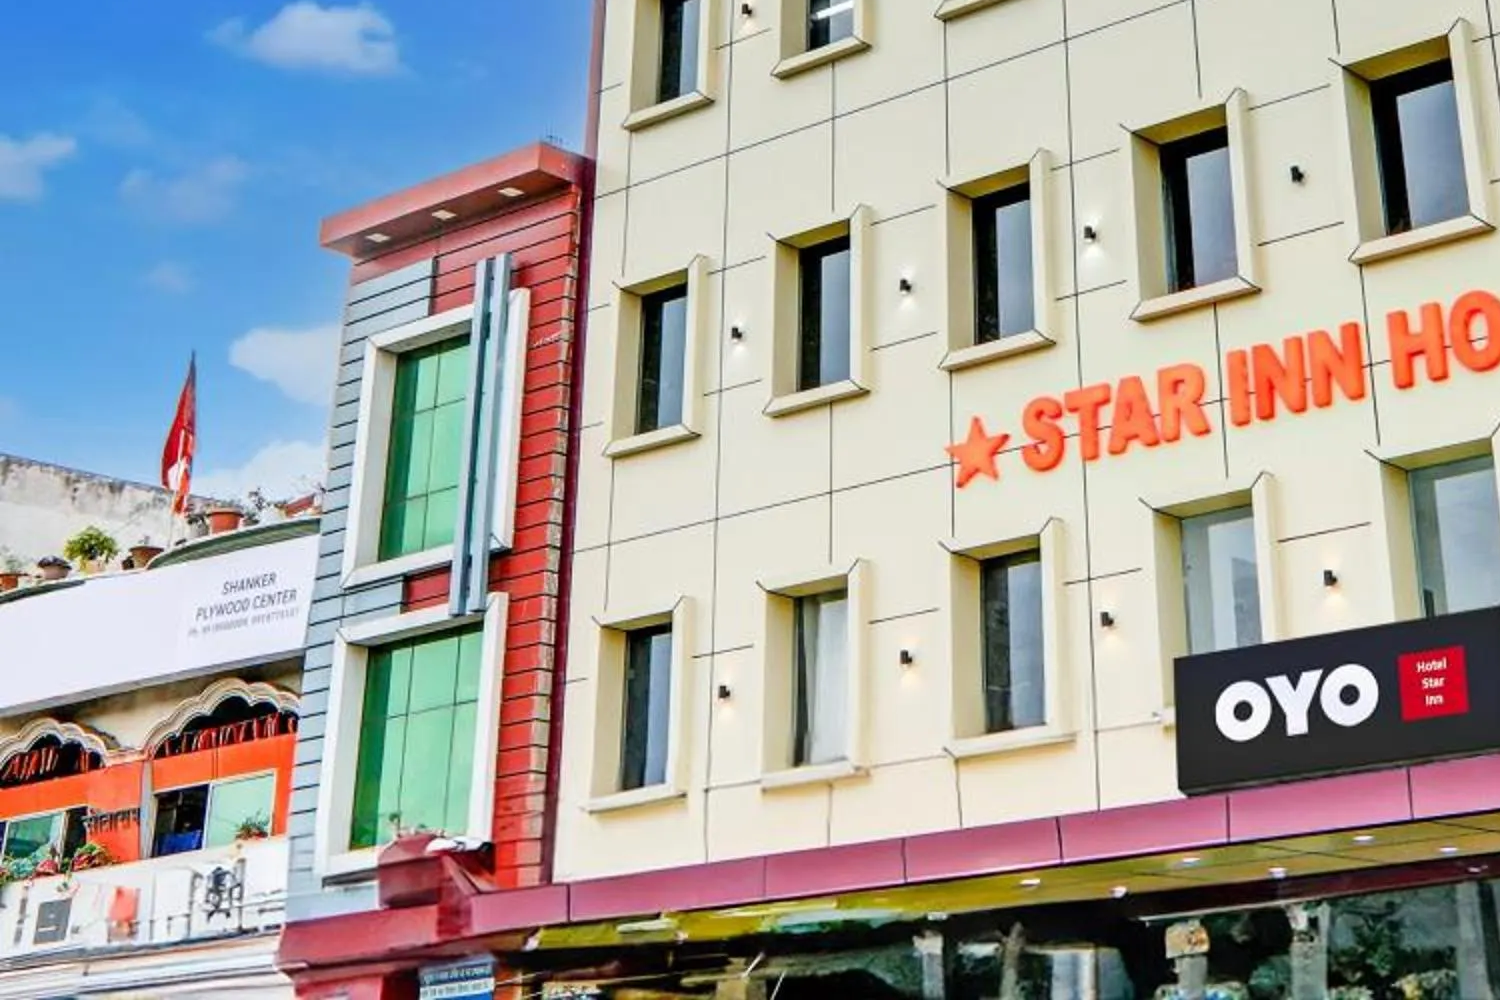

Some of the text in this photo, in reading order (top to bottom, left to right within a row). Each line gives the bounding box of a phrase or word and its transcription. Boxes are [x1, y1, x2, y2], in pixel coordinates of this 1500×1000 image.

[1022, 363, 1212, 472] STAR
[1226, 322, 1366, 427] INN
[222, 571, 277, 595] SHANKER
[195, 589, 297, 621] PLYWOOD CENTER
[1416, 657, 1447, 672] Hotel
[1421, 676, 1445, 690] Star
[1215, 663, 1379, 742] OYO
[1425, 695, 1444, 706] Inn
